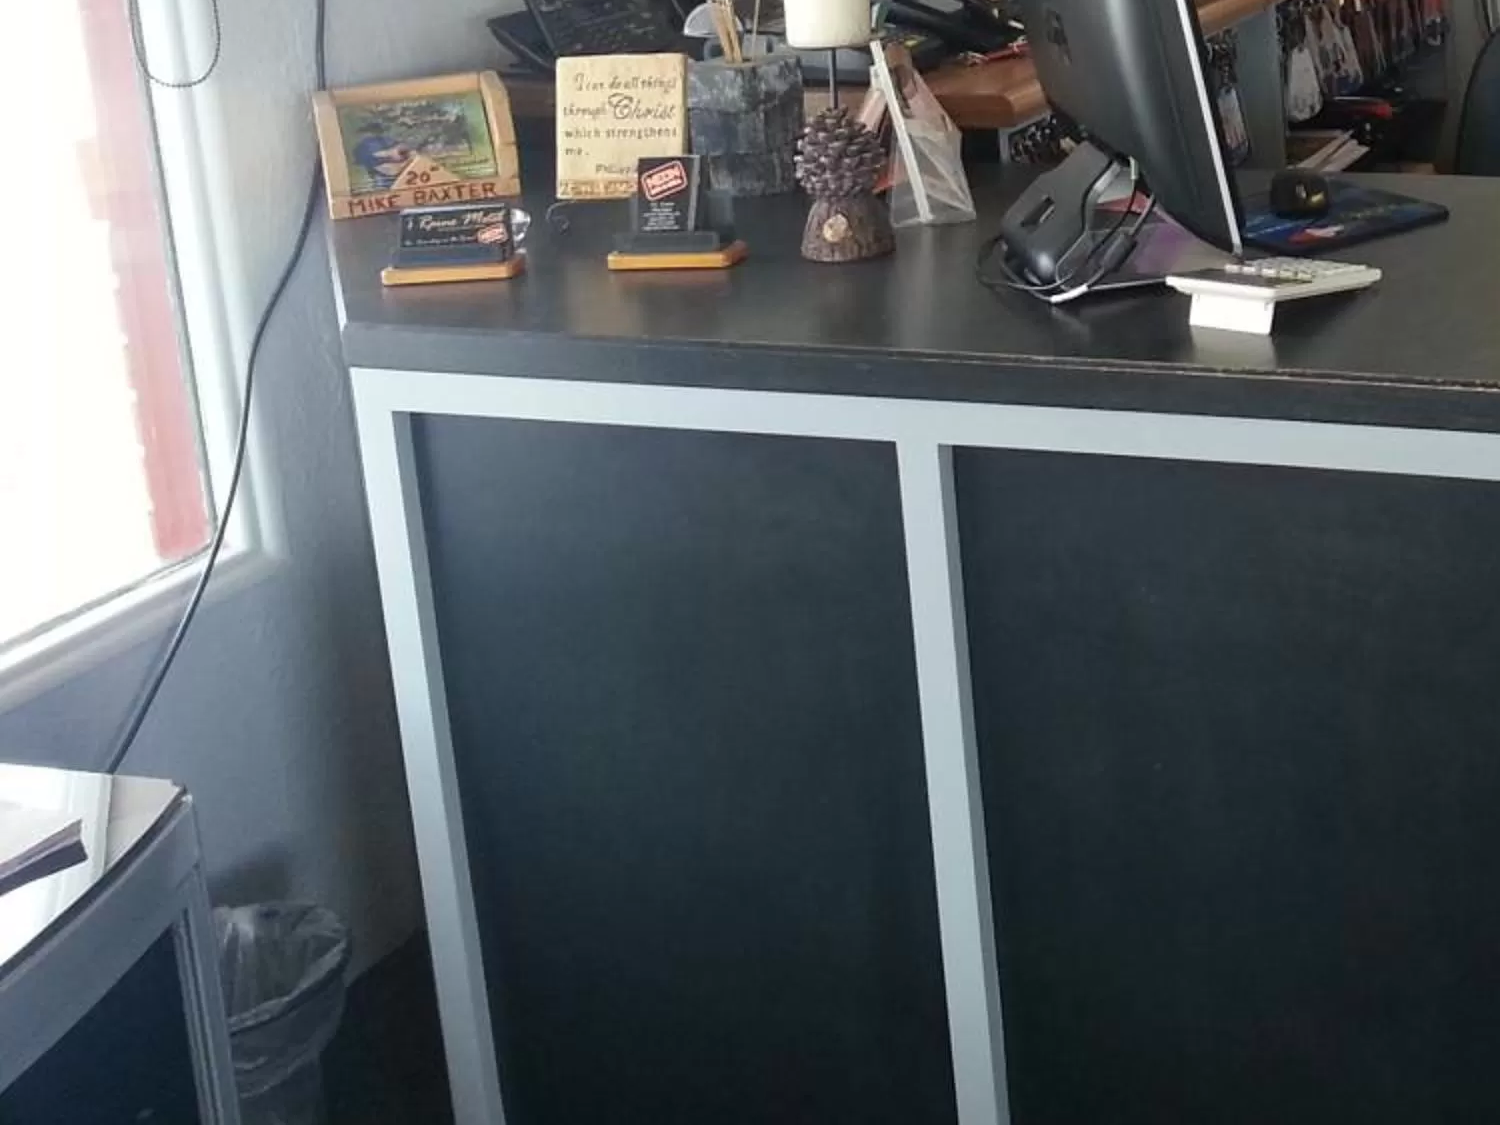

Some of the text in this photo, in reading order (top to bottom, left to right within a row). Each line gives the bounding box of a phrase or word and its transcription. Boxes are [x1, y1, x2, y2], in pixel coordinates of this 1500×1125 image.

[607, 92, 677, 120] Christ
[564, 126, 678, 140] which strengthens
[348, 182, 496, 217] MIKE BAXTER
